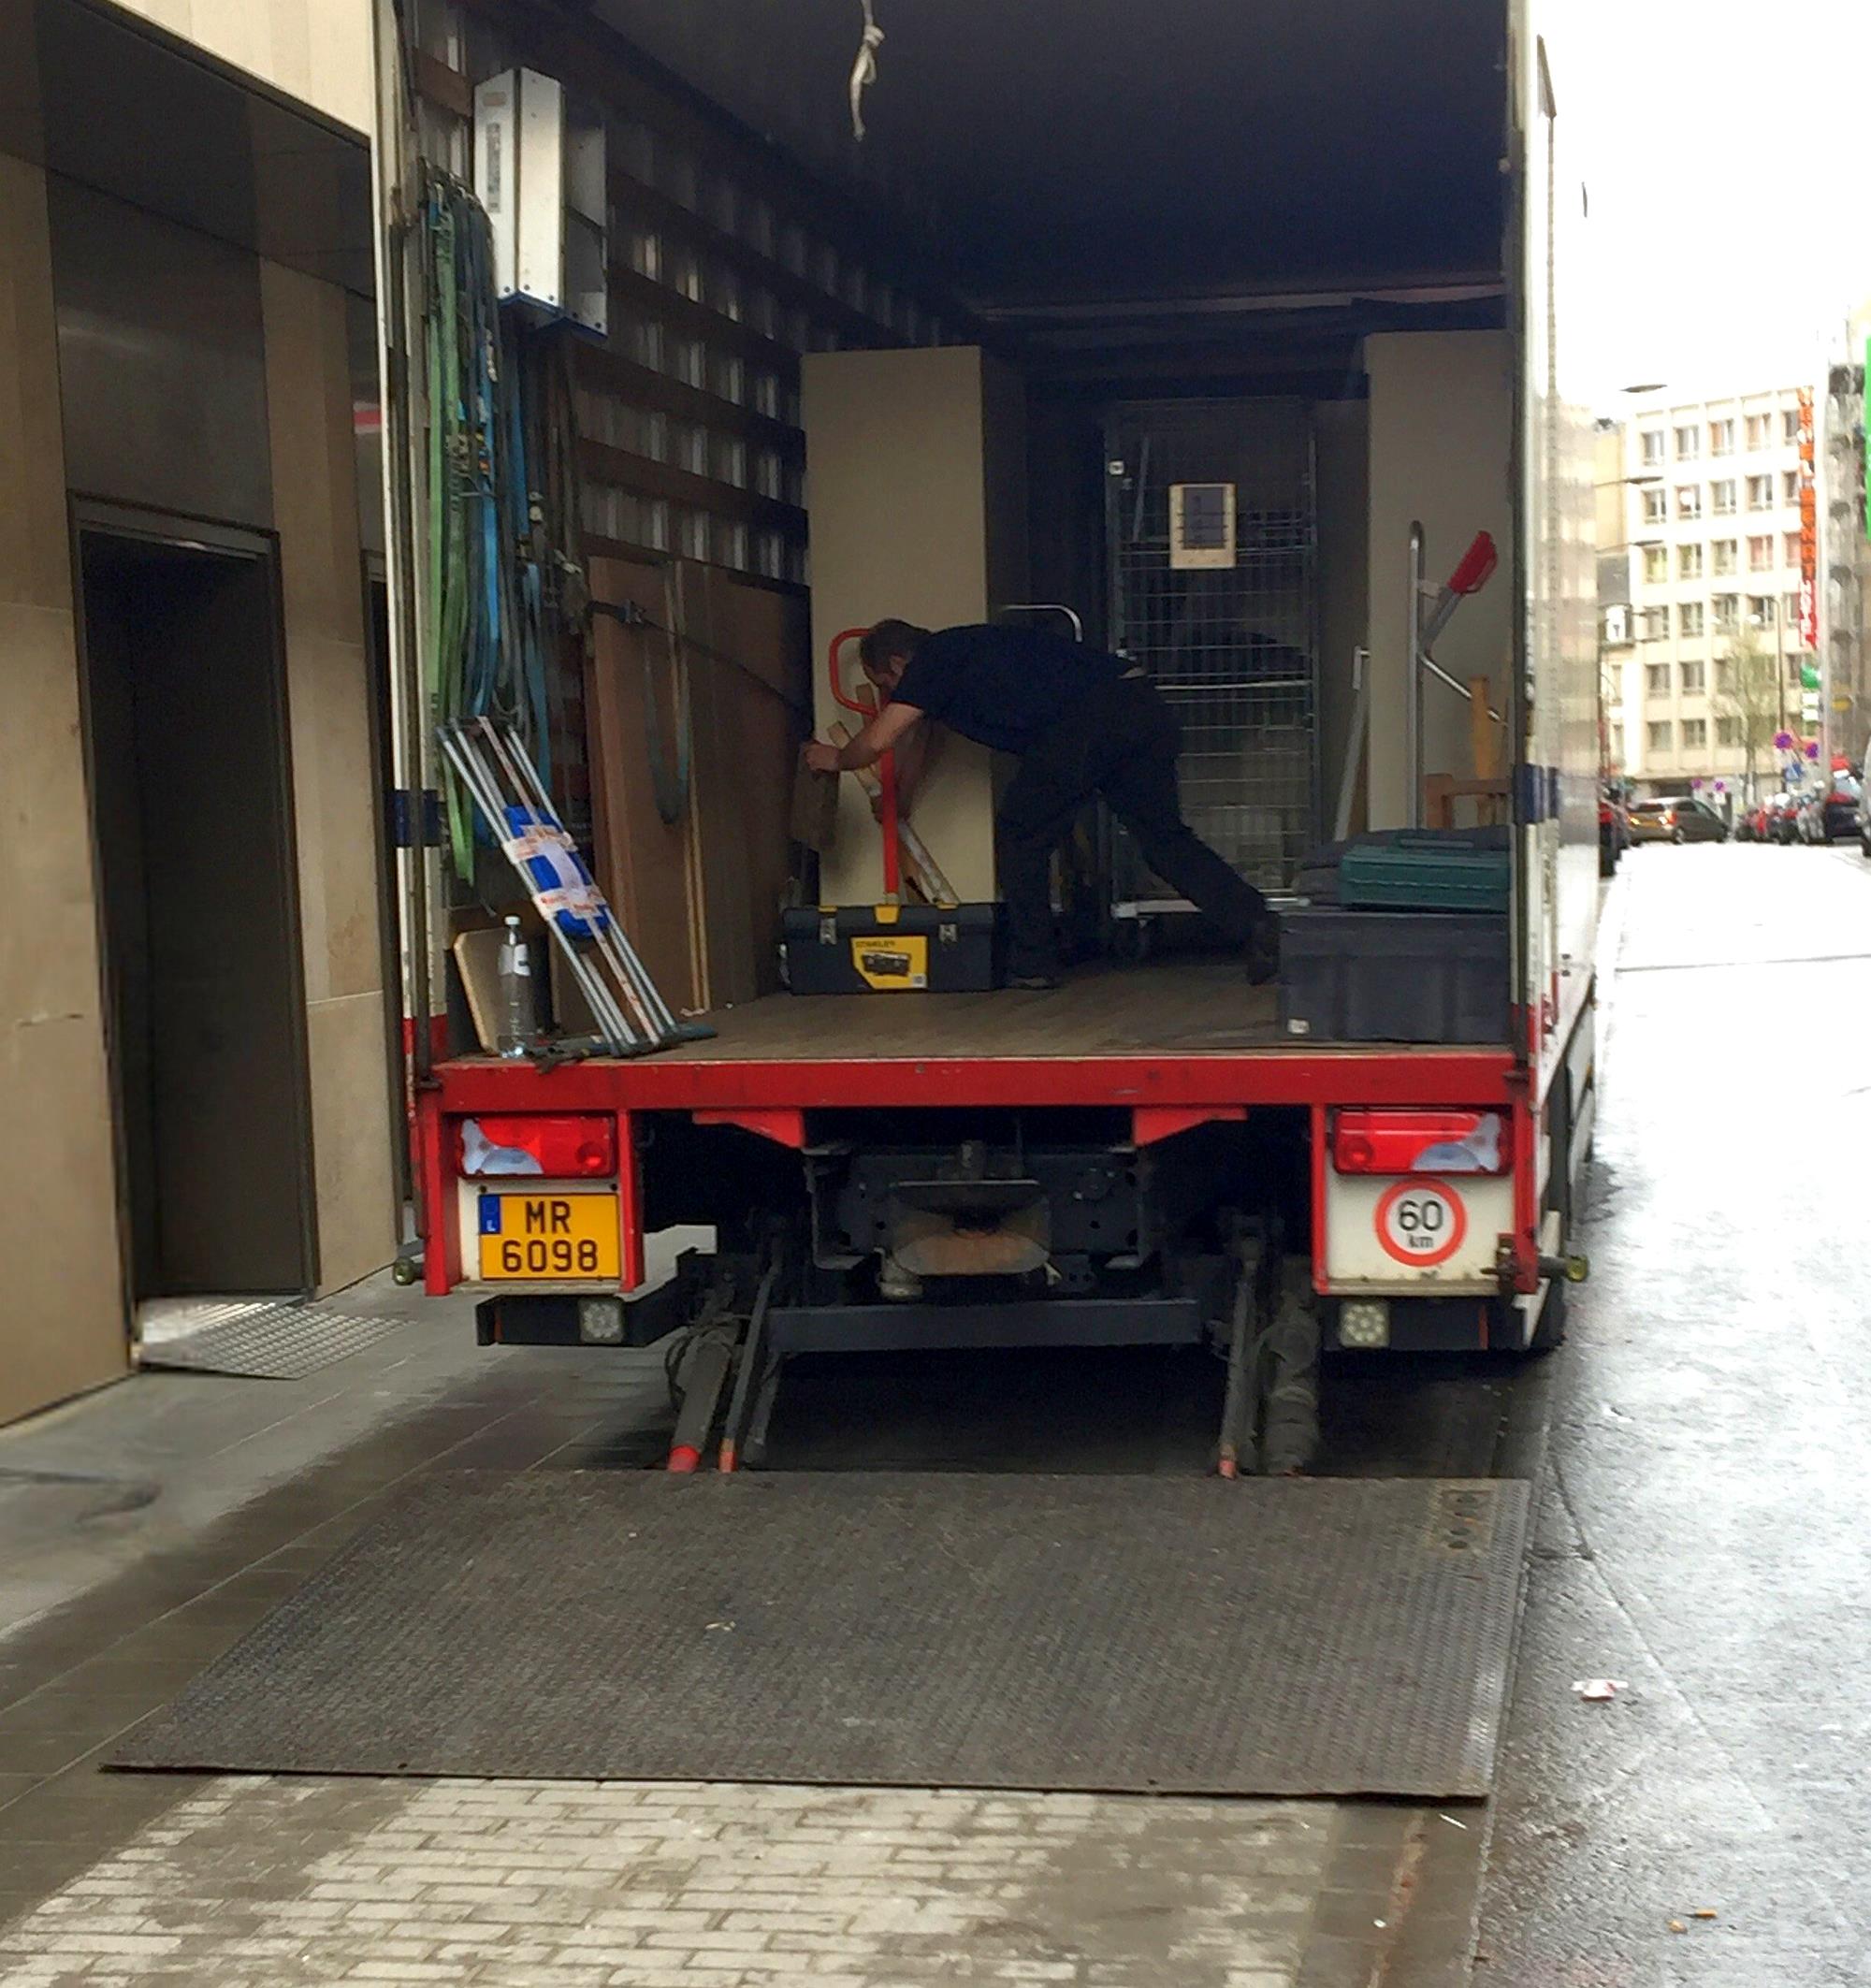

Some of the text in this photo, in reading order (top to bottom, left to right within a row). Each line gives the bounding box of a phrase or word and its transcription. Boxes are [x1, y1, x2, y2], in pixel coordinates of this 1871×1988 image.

[486, 1220, 497, 1232] L
[525, 1200, 571, 1234] MR
[1399, 1199, 1443, 1231] 60
[502, 1240, 599, 1272] 6098
[1408, 1233, 1433, 1248] km
